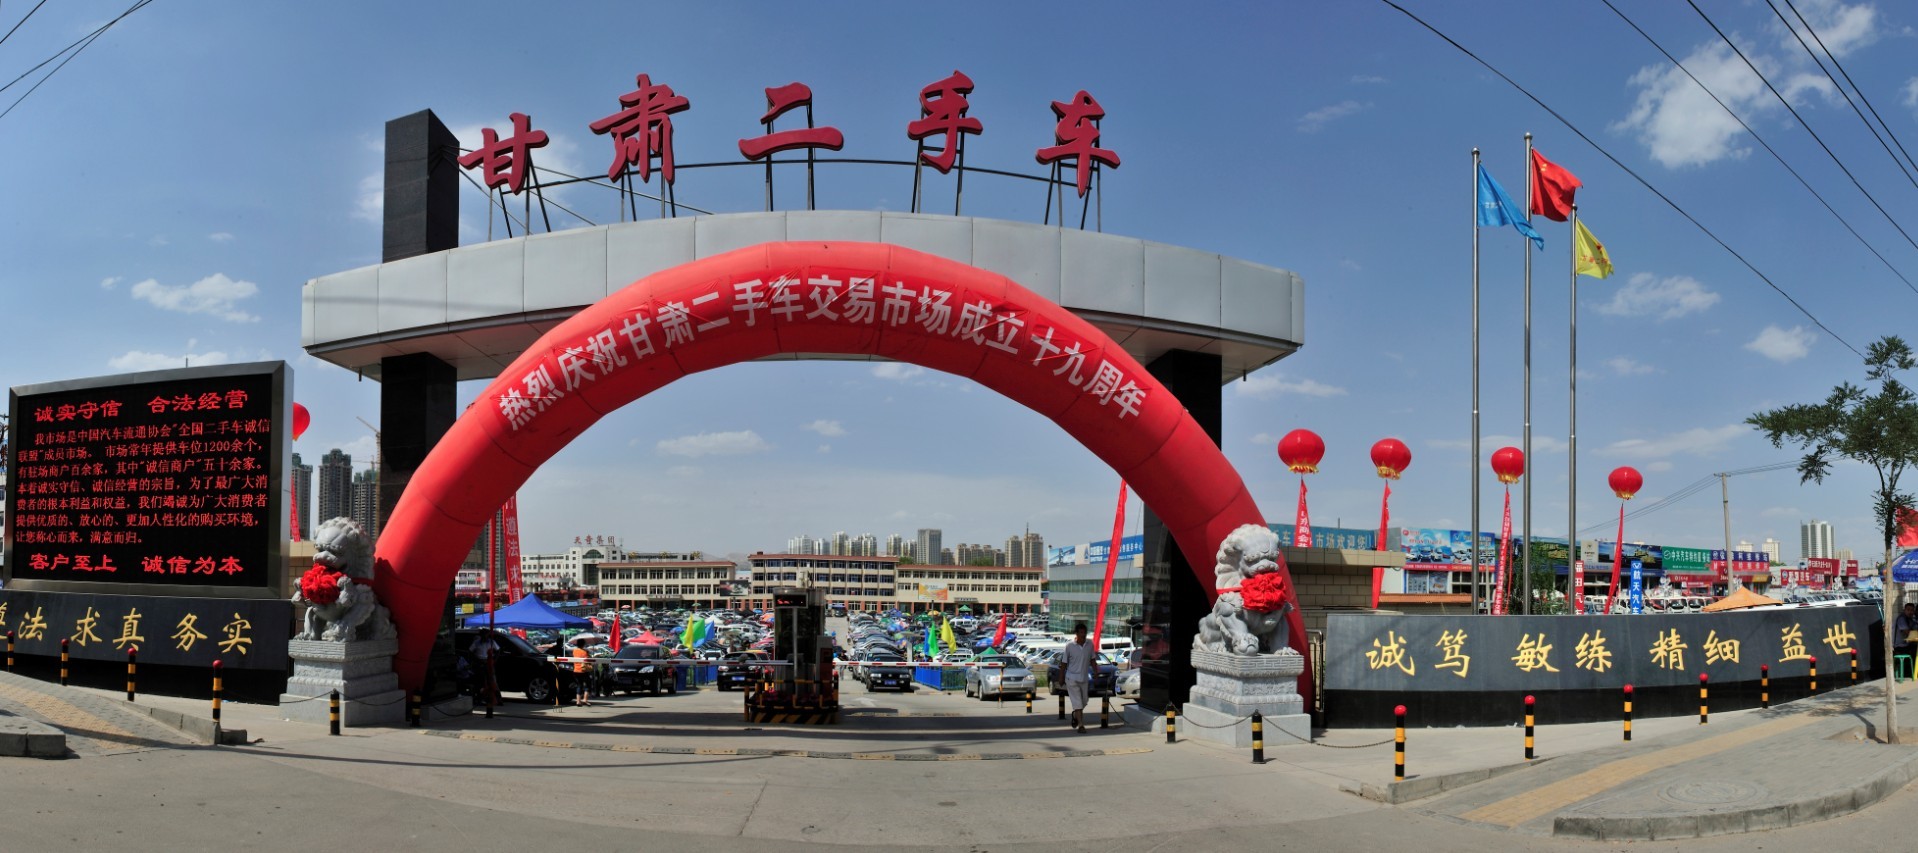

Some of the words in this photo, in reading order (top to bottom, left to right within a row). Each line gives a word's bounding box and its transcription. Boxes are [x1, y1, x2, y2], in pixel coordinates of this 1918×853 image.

[457, 70, 1121, 198] 甘肃二手车
[498, 274, 1148, 431] 热烈庆祝甘肃二手车交易市场成立十九周年
[34, 400, 123, 423] 诚实守信
[147, 390, 248, 414] 合法经营
[29, 553, 118, 573] 客户至上
[141, 555, 244, 576] 诚信为本
[71, 607, 145, 651] 求真
[171, 613, 253, 655] 务实
[1365, 629, 1470, 677] 诚笃
[1511, 630, 1613, 673] 敏练
[1649, 630, 1741, 670] 精细
[1778, 621, 1857, 662] 益世
